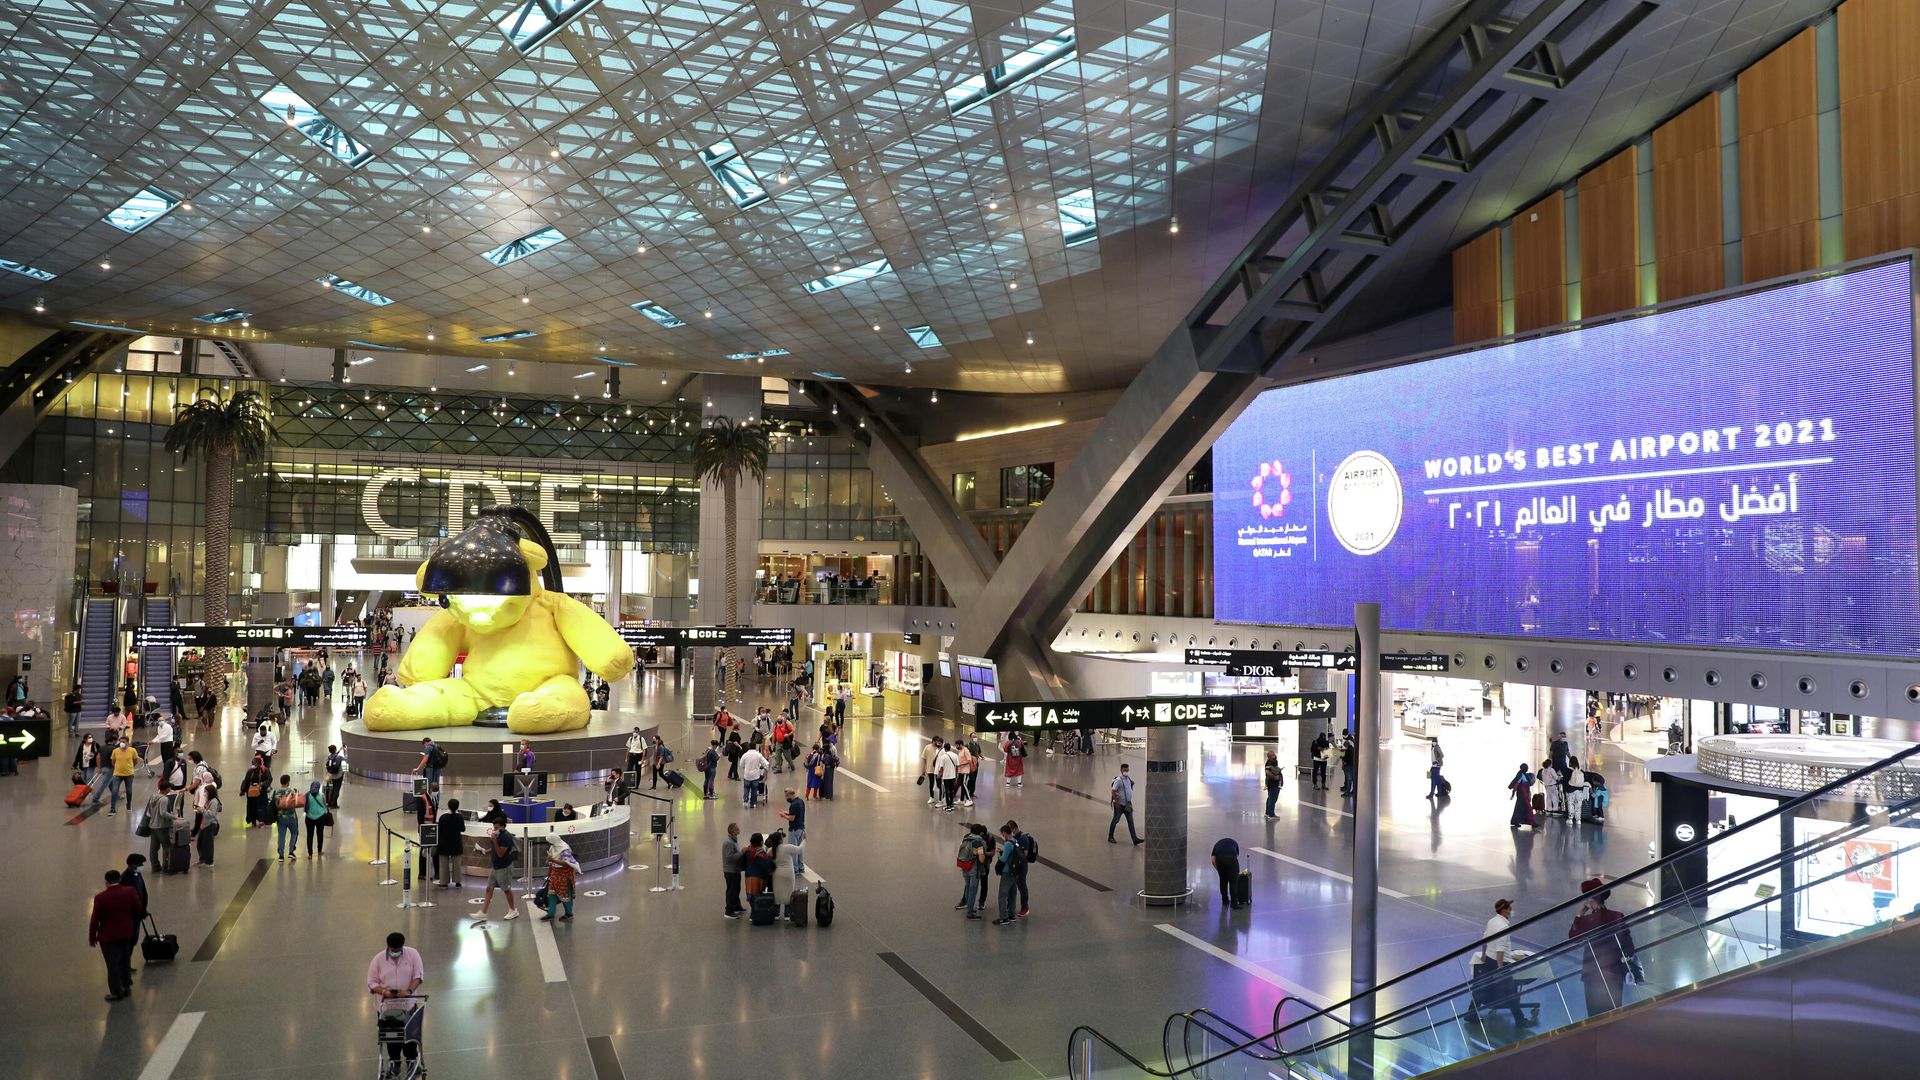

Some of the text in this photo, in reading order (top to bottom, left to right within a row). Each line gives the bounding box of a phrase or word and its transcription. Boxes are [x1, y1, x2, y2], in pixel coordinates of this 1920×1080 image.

[1424, 417, 1837, 479] WORLD'S BEST AIRPORT 2021
[1344, 468, 1384, 480] AIRPORT
[1719, 472, 1800, 522] أفضل
[1515, 496, 1577, 533] العالم
[1588, 494, 1631, 534] في
[1642, 489, 1705, 528] مطار
[248, 629, 271, 638] CDE
[698, 630, 718, 638] CDE
[1243, 665, 1274, 676] DIOR
[1045, 708, 1059, 724] A
[1174, 704, 1207, 720] CDE
[1275, 701, 1285, 715] B
